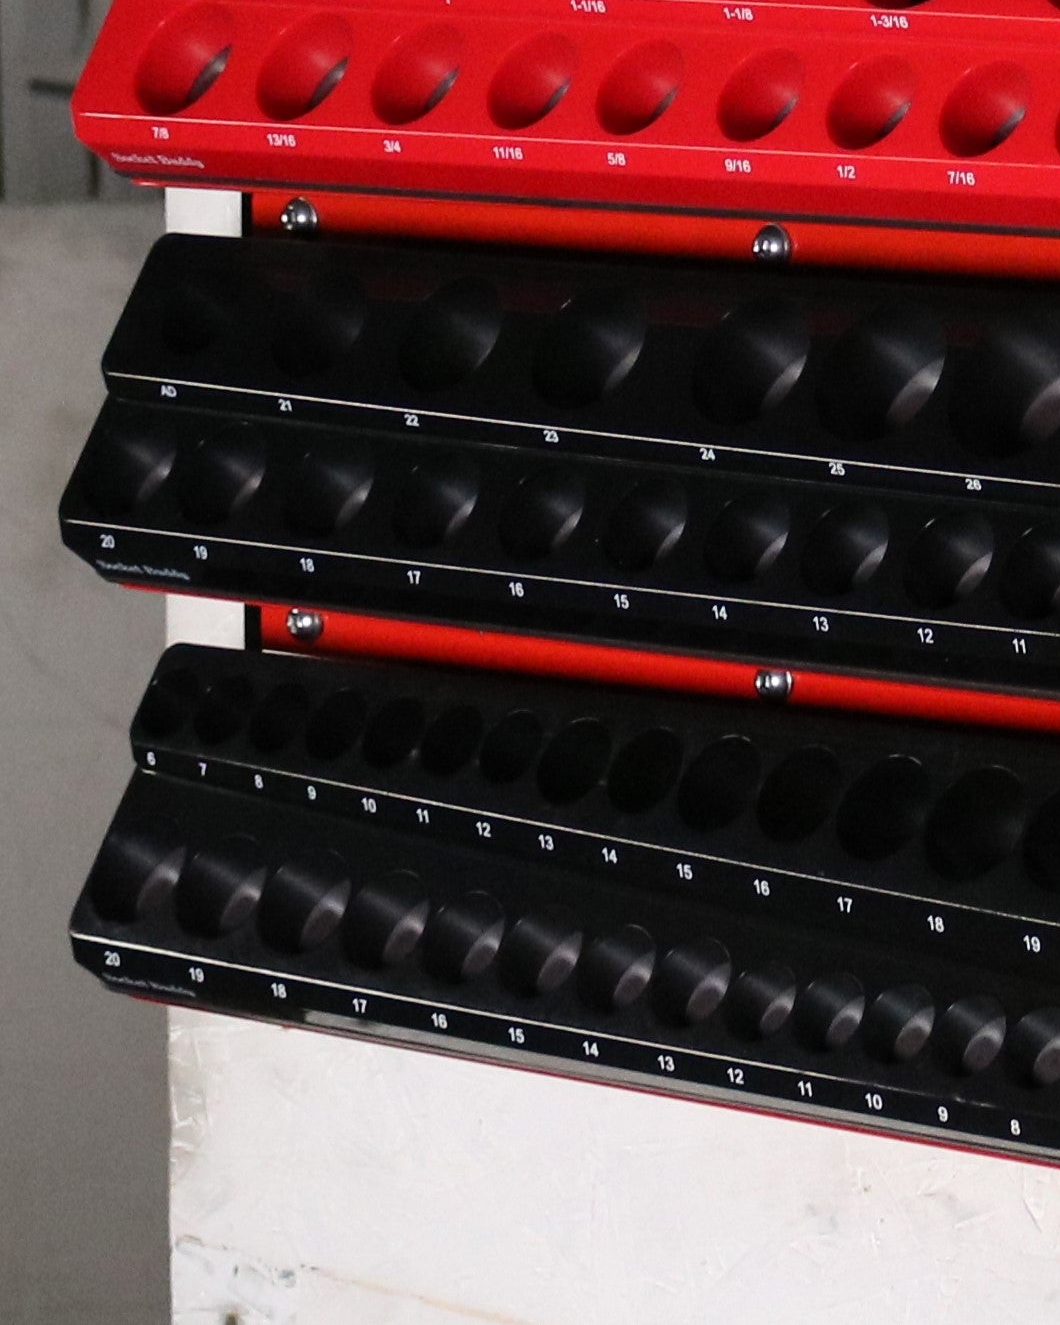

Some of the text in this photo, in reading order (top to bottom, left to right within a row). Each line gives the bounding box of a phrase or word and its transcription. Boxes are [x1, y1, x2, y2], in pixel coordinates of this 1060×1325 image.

[570, 0, 606, 13] 1-1/16
[723, 7, 754, 21] 1-1/8
[870, 14, 909, 29] 1-3/16
[266, 133, 297, 148] 13/16
[383, 139, 402, 153] 3/4
[492, 146, 524, 160] 11/16
[607, 152, 627, 166] 5/8
[724, 158, 752, 173] 9/16
[836, 165, 856, 179] 1/2
[947, 170, 976, 186] 7/16
[278, 398, 293, 412] 21
[403, 413, 420, 427] 22
[542, 429, 559, 443] 23
[699, 446, 717, 462] 24
[828, 461, 846, 477] 25
[964, 478, 982, 491] 26
[193, 545, 208, 560] 19
[299, 557, 315, 573] 18
[406, 570, 421, 585] 17
[508, 581, 525, 598] 16
[613, 593, 630, 610] 15
[711, 604, 728, 620] 14
[812, 615, 829, 632] 13
[917, 627, 934, 644] 12
[1012, 638, 1027, 654] 11
[198, 762, 207, 776] 7
[307, 785, 317, 800] 9
[361, 797, 377, 813] 10
[415, 808, 430, 824] 11
[475, 821, 492, 838] 12
[538, 834, 554, 851] 13
[601, 847, 618, 864] 14
[676, 862, 693, 880] 15
[753, 878, 770, 897] 16
[837, 896, 853, 913] 17
[927, 915, 945, 933] 18
[1023, 934, 1041, 953] 19
[188, 967, 205, 983] 19
[270, 982, 287, 999] 18
[352, 998, 368, 1014] 17
[431, 1012, 448, 1029] 16
[508, 1026, 525, 1044] 15
[582, 1040, 599, 1057] 14
[657, 1054, 675, 1072] 13
[726, 1067, 745, 1085] 12
[797, 1080, 813, 1098] 11
[864, 1092, 883, 1110] 10
[937, 1106, 949, 1123] 9
[1010, 1119, 1021, 1136] 8
